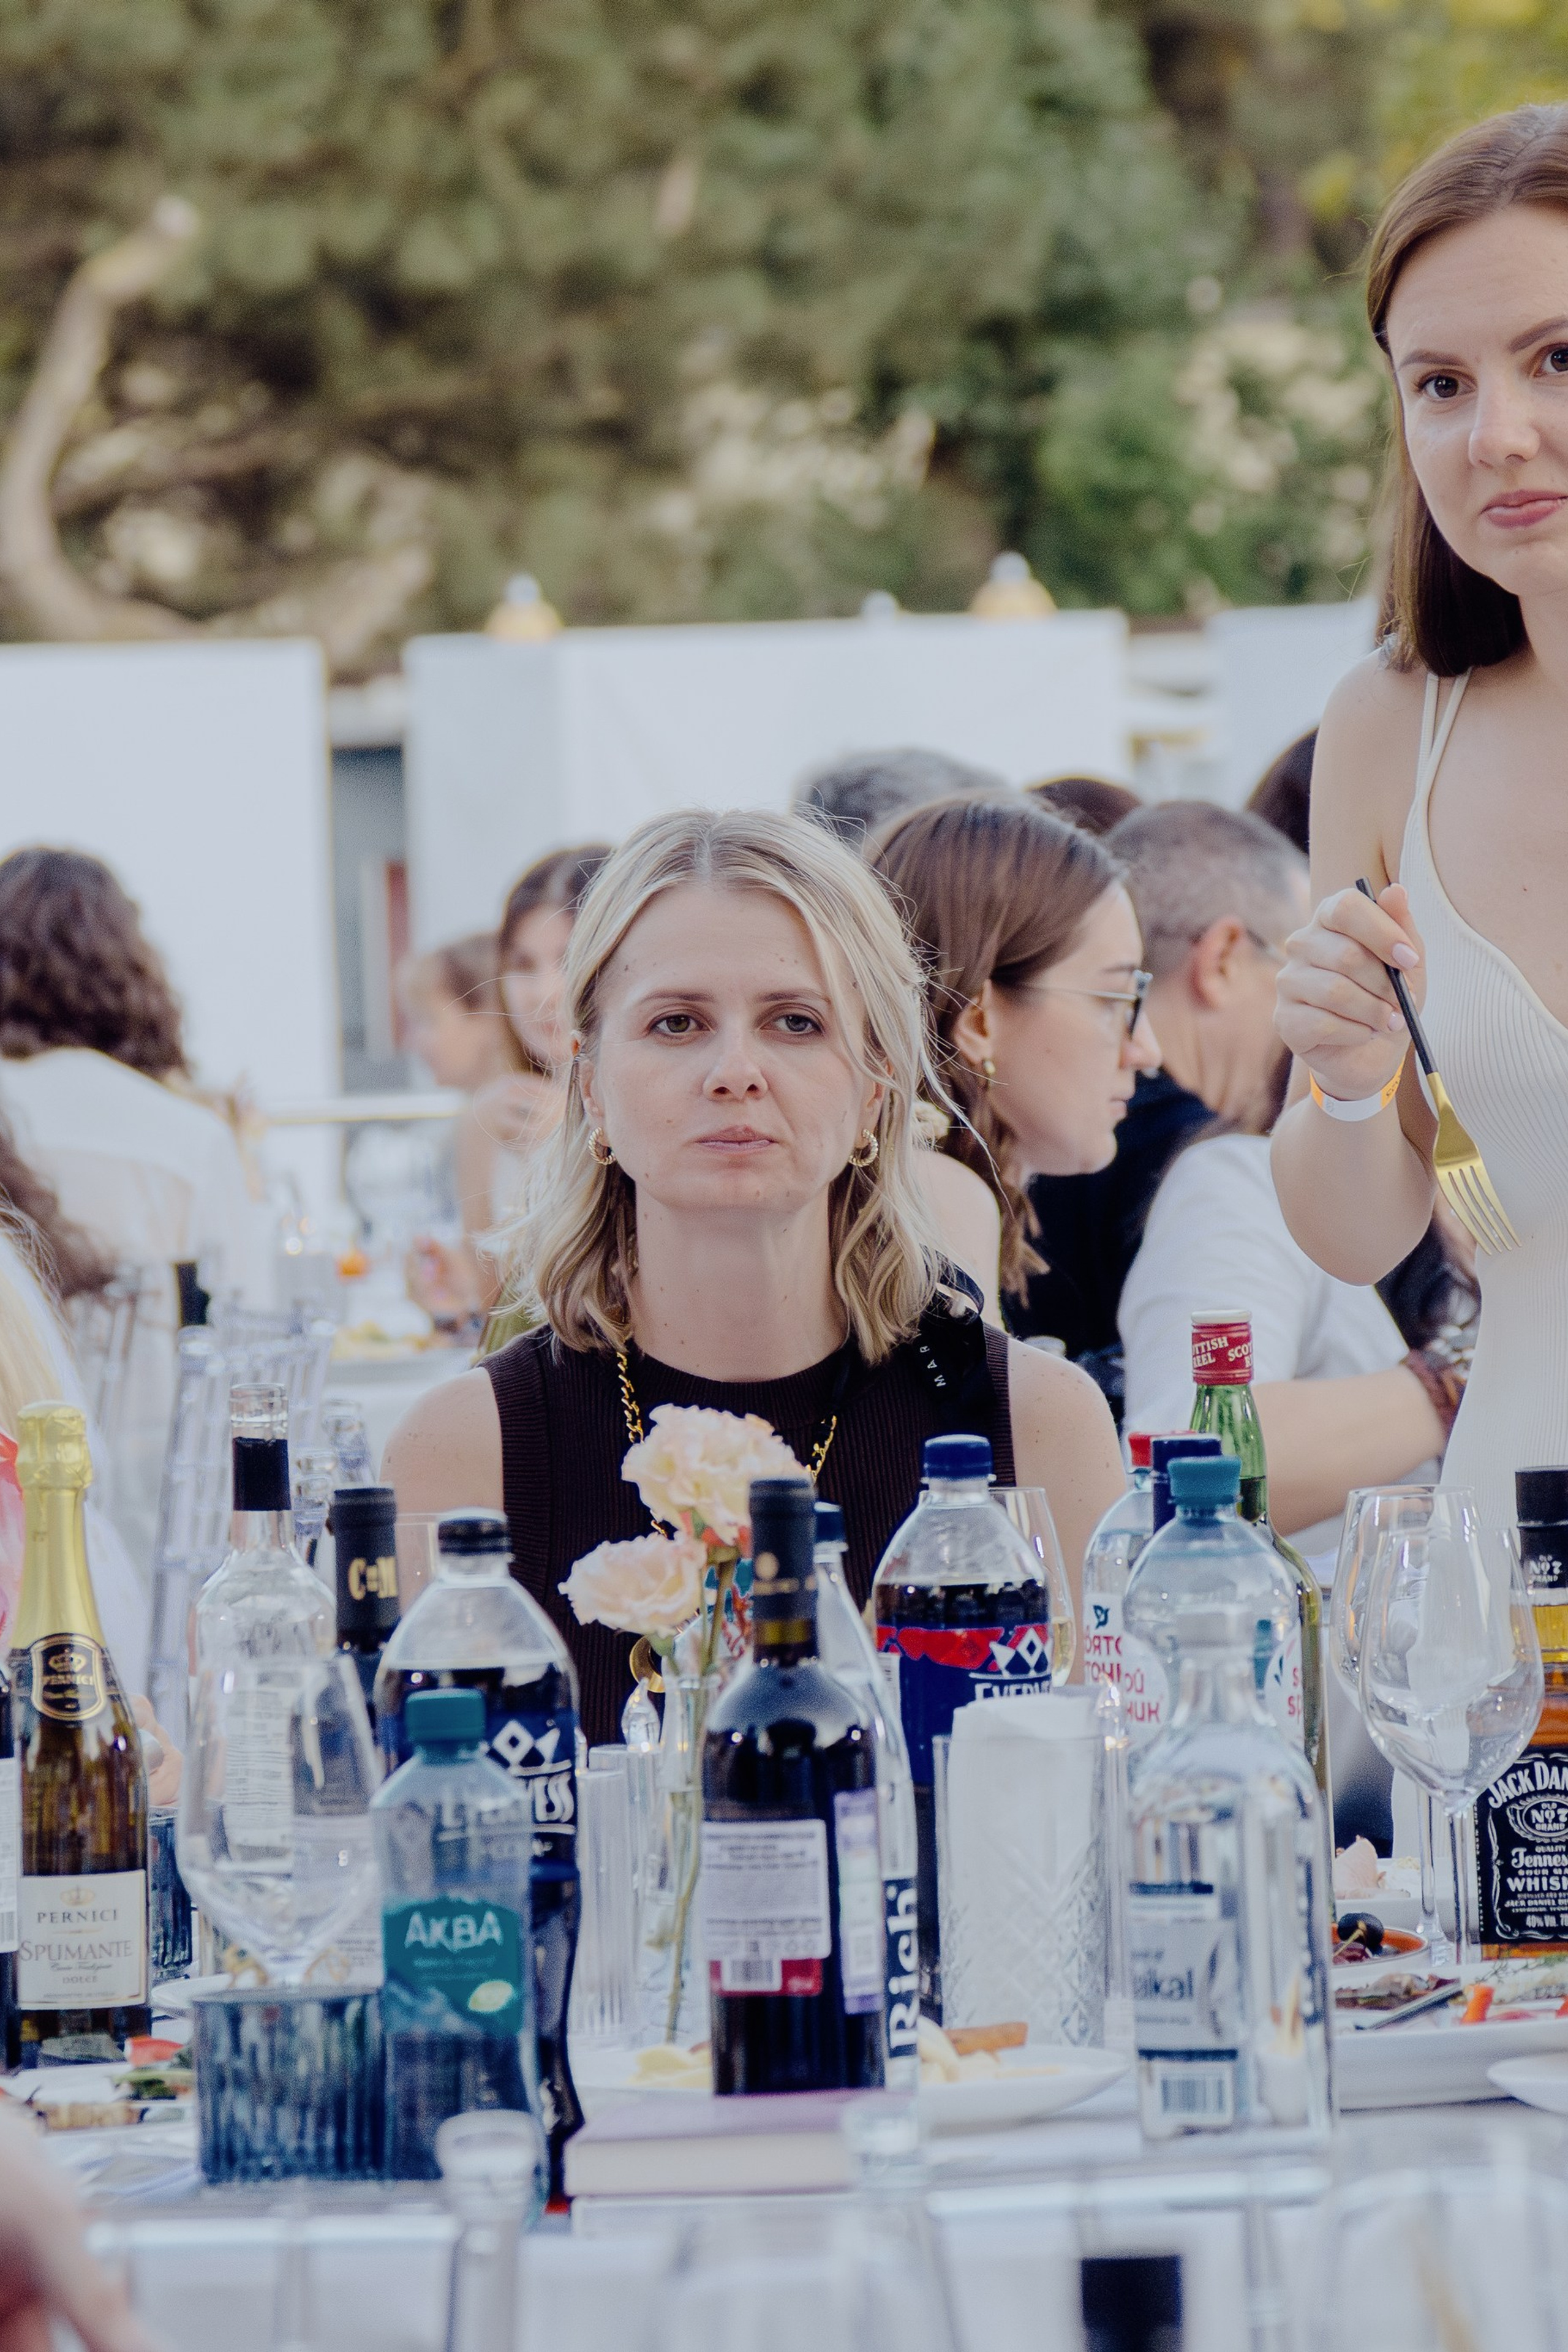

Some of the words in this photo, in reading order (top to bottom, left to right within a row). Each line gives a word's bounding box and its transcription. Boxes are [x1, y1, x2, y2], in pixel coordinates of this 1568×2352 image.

[1488, 1768, 1535, 1808] JACK
[1535, 1822, 1566, 1832] BRAND
[1535, 1844, 1566, 1853] QUALITY
[37, 1909, 118, 1924] PERNICI
[20, 1940, 133, 1961] SPUMANTE
[62, 1975, 97, 1985] DOLCE
